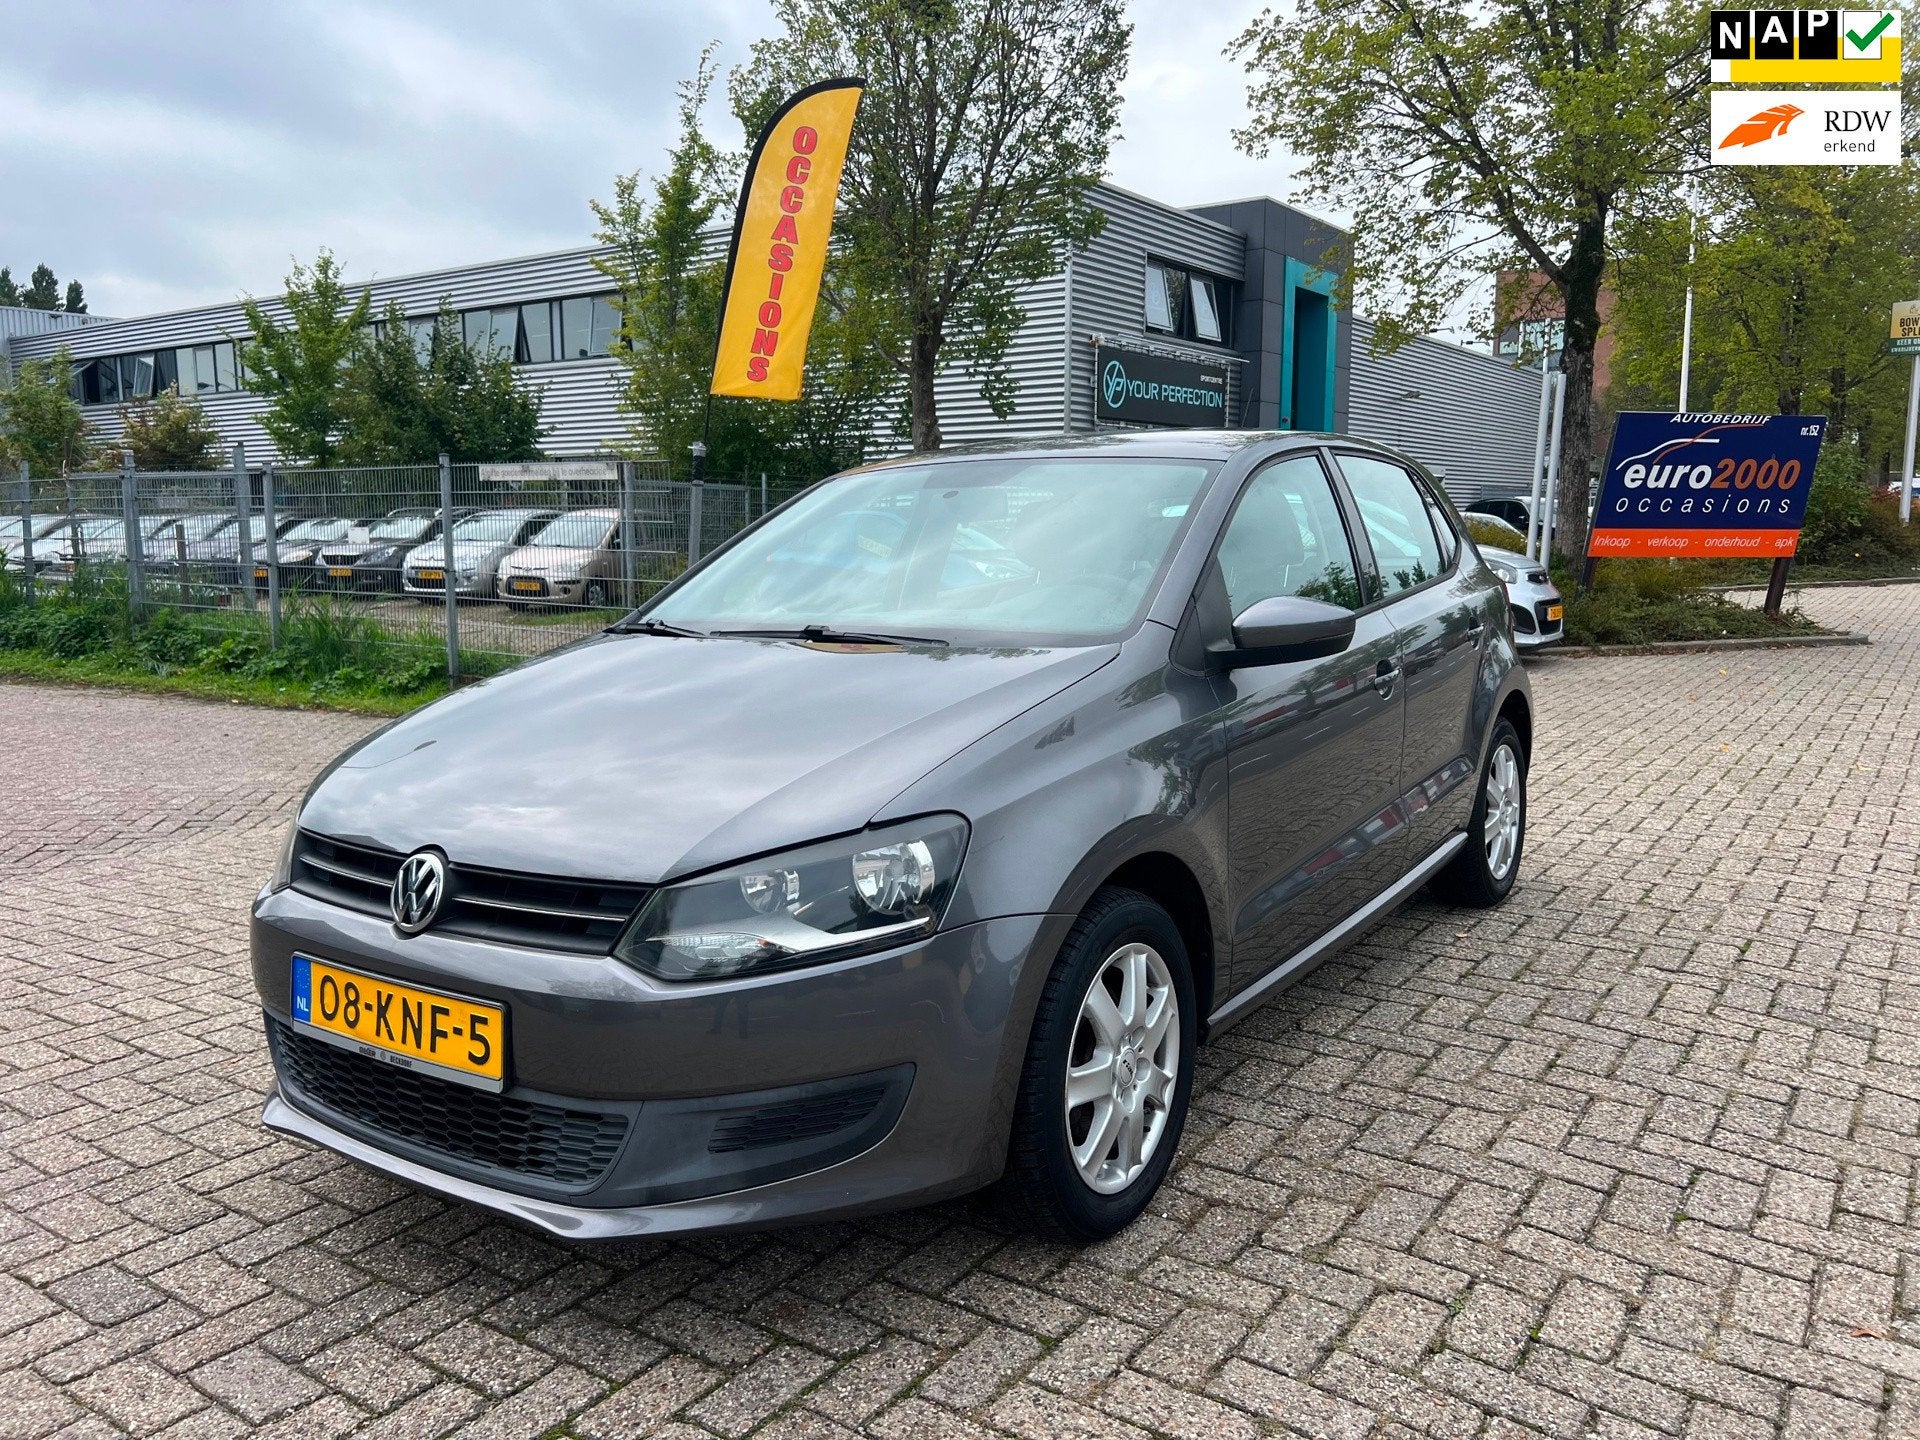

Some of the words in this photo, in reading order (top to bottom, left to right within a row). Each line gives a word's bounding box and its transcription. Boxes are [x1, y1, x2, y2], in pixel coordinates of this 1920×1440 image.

[747, 125, 818, 382] OCCASIONS
[1126, 379, 1159, 400] YOUR
[1161, 384, 1223, 408] PERFECTION
[1670, 414, 1771, 425] AUTOBEDRIJF
[1800, 425, 1820, 436] nr.152
[1623, 458, 1801, 490] euro2000
[1615, 494, 1790, 513] occasions
[1594, 536, 1631, 548] Inkoop
[1647, 537, 1689, 548] verkoop
[1704, 536, 1760, 548] onderhoud
[1774, 537, 1793, 549] apk
[296, 996, 309, 1012] NL
[319, 974, 491, 1066] 08-KNF-5
